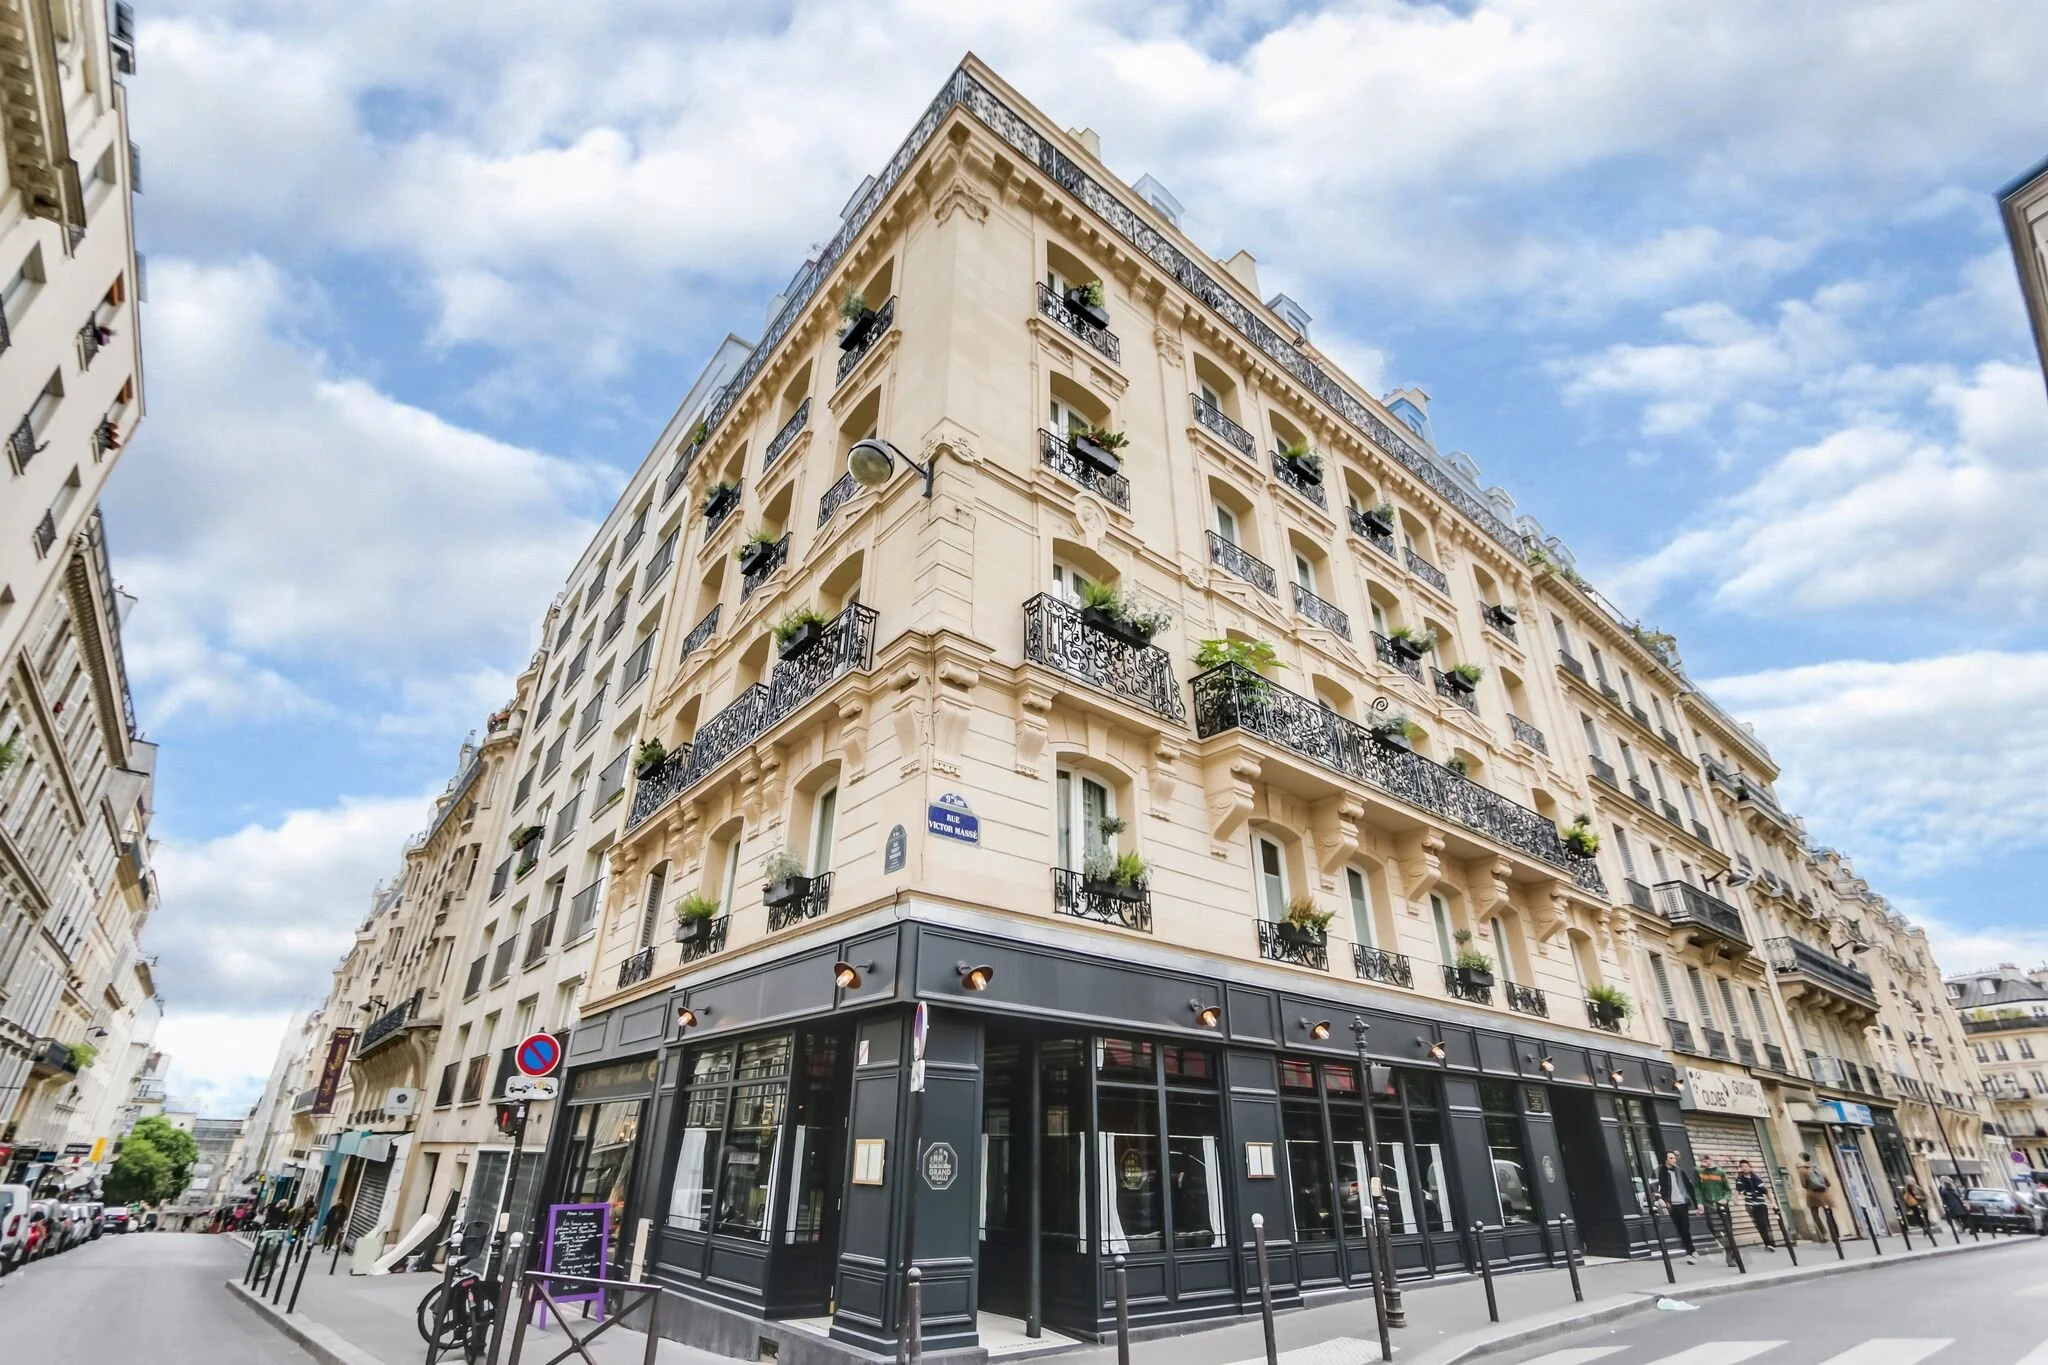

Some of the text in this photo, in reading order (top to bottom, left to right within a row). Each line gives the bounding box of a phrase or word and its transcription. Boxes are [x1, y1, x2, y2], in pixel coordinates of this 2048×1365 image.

[946, 814, 960, 824] RUE
[928, 820, 978, 839] VICTOR MASSÉ
[1701, 1089, 1728, 1107] OLDIES
